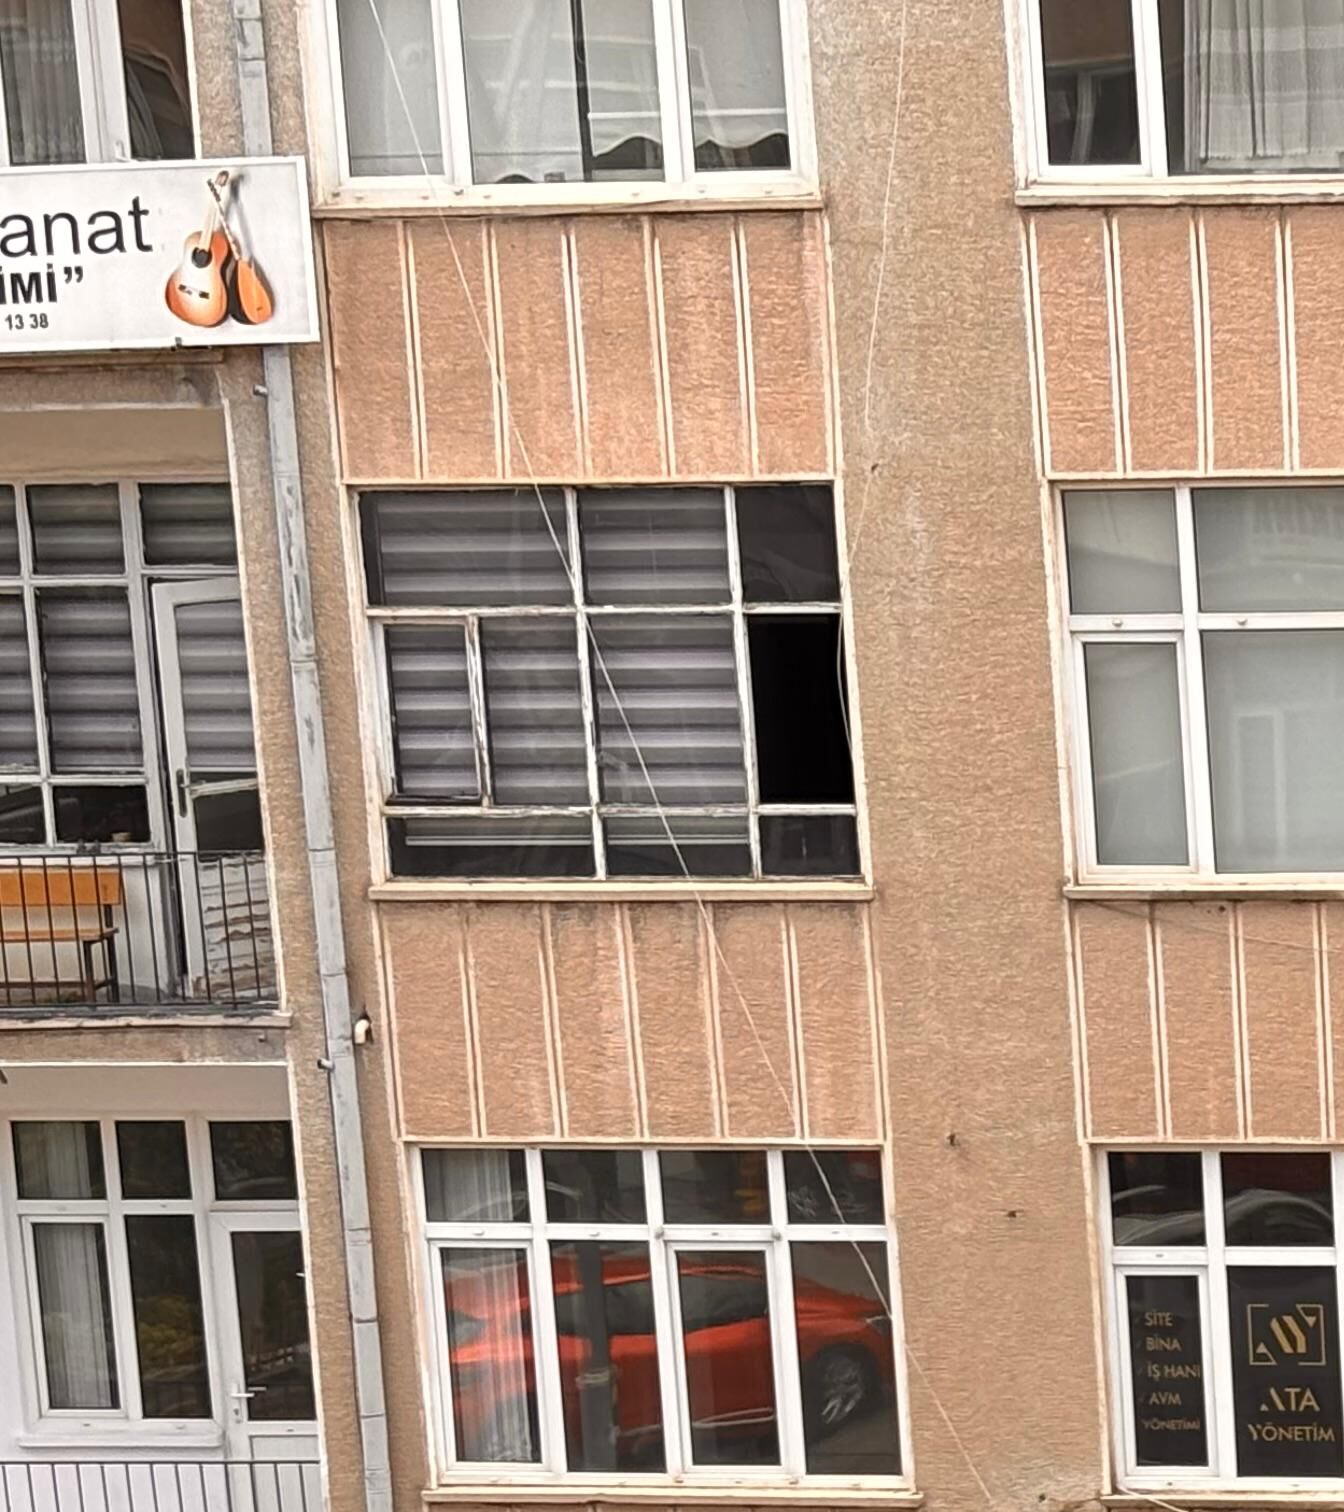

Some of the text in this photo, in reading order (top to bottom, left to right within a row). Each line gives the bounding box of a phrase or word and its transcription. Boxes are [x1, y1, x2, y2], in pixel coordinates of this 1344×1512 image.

[5, 312, 49, 331] 13 38
[1145, 1309, 1173, 1326] SİTE
[1146, 1334, 1181, 1351] BİNA
[1150, 1392, 1181, 1405] AVM
[1260, 1387, 1320, 1411] ATA
[1248, 1422, 1335, 1442] YÖNETİM
